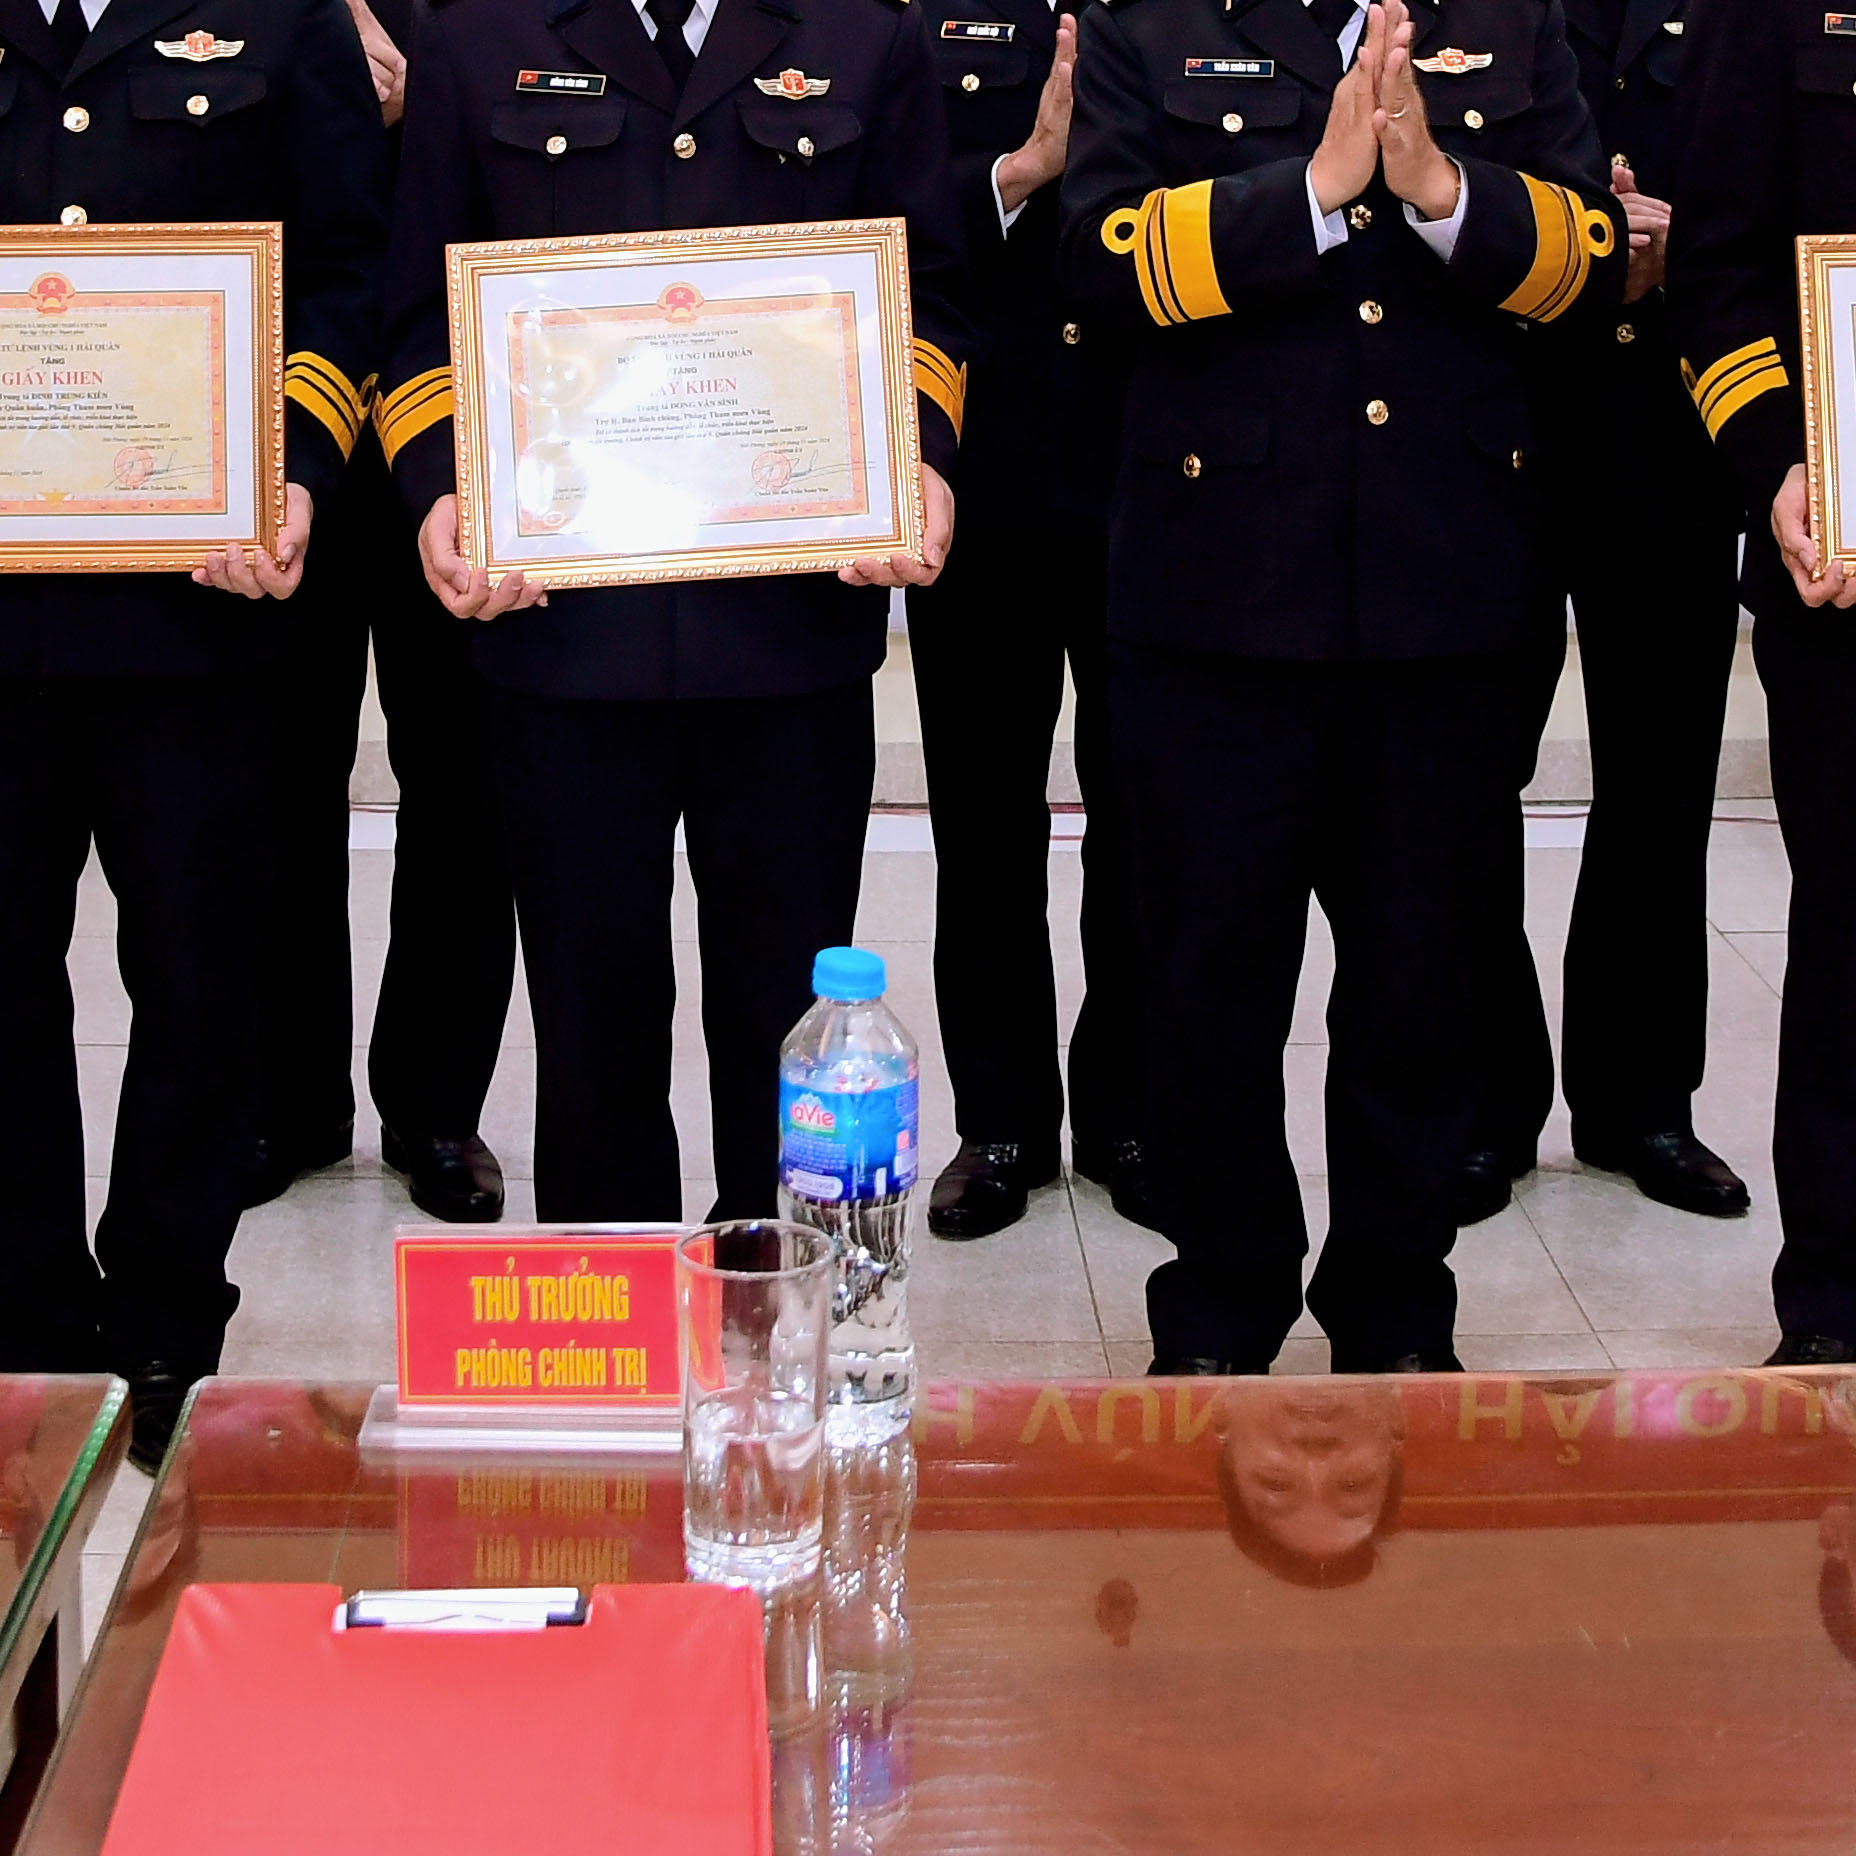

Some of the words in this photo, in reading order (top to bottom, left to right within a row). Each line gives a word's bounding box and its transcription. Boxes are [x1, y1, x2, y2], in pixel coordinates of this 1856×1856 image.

[1, 368, 47, 386] GIẤY
[53, 371, 103, 385] KHEN
[686, 378, 737, 395] KHEN
[469, 1256, 521, 1322] THỦ
[526, 1256, 630, 1322] TRƯỞNG
[455, 1338, 532, 1387] PHÒNG
[538, 1339, 607, 1387] CHÍNH
[612, 1347, 647, 1395] TRỊ
